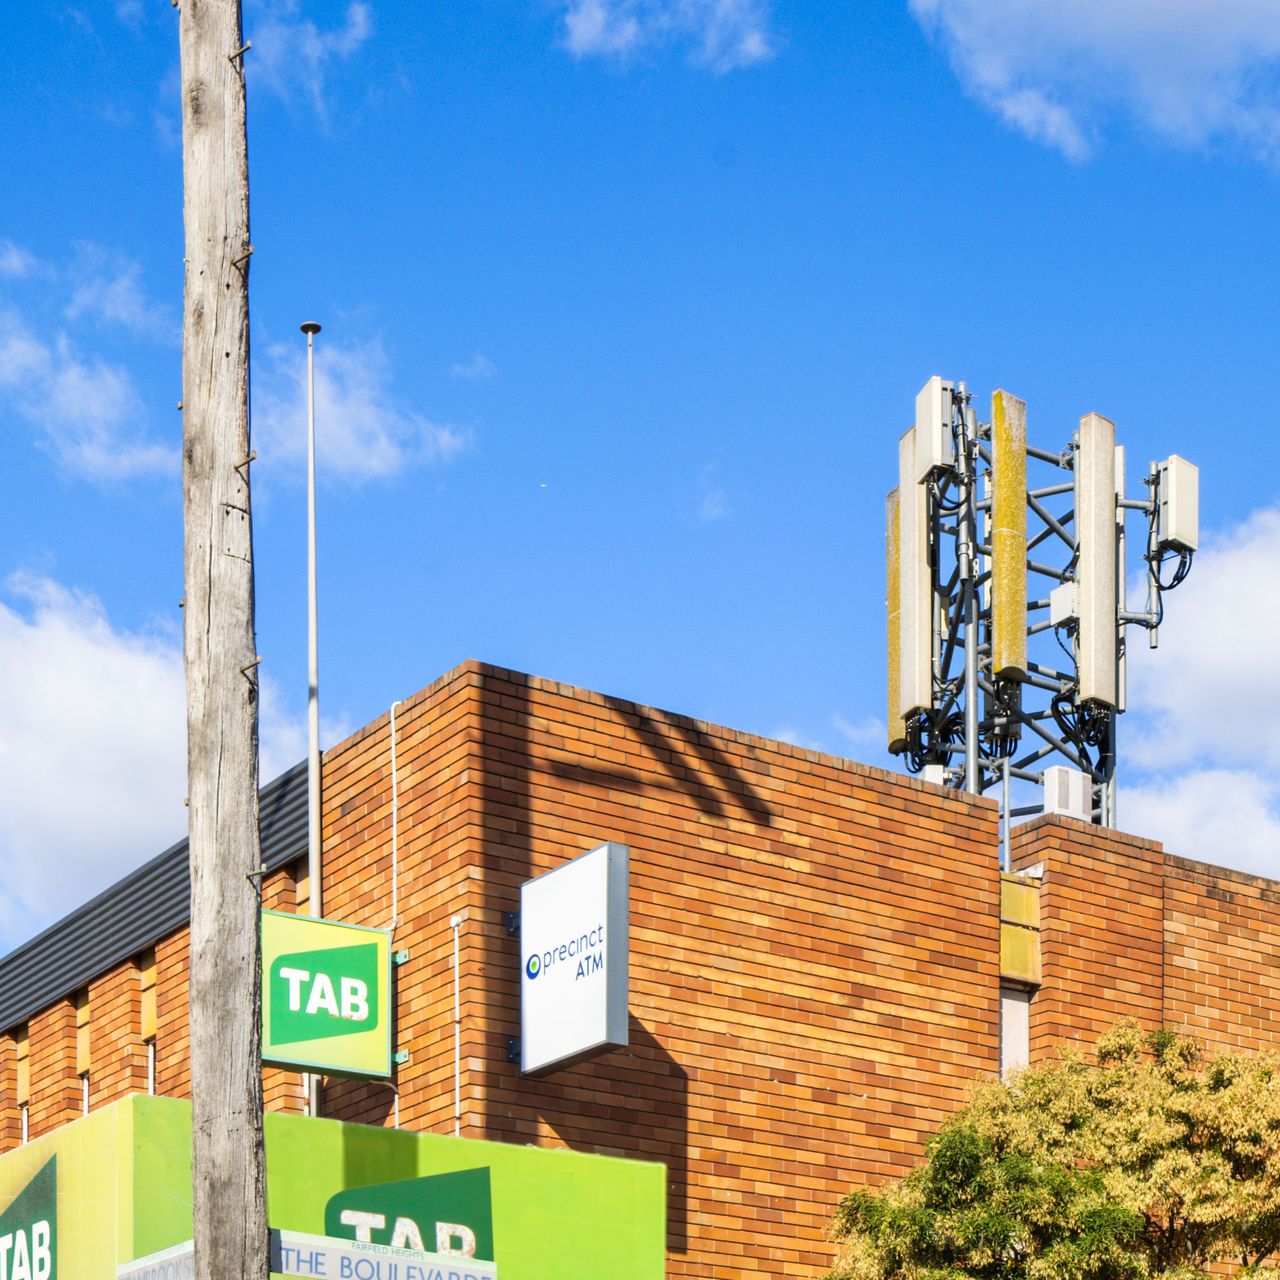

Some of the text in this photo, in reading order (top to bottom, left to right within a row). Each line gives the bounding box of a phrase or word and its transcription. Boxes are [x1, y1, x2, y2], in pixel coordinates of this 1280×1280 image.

[543, 924, 604, 975] precinct
[575, 951, 604, 981] ATM
[279, 967, 369, 1020] TAB
[281, 1247, 327, 1276] THE
[352, 1242, 424, 1260] FAIRFIELD HEIGHTS
